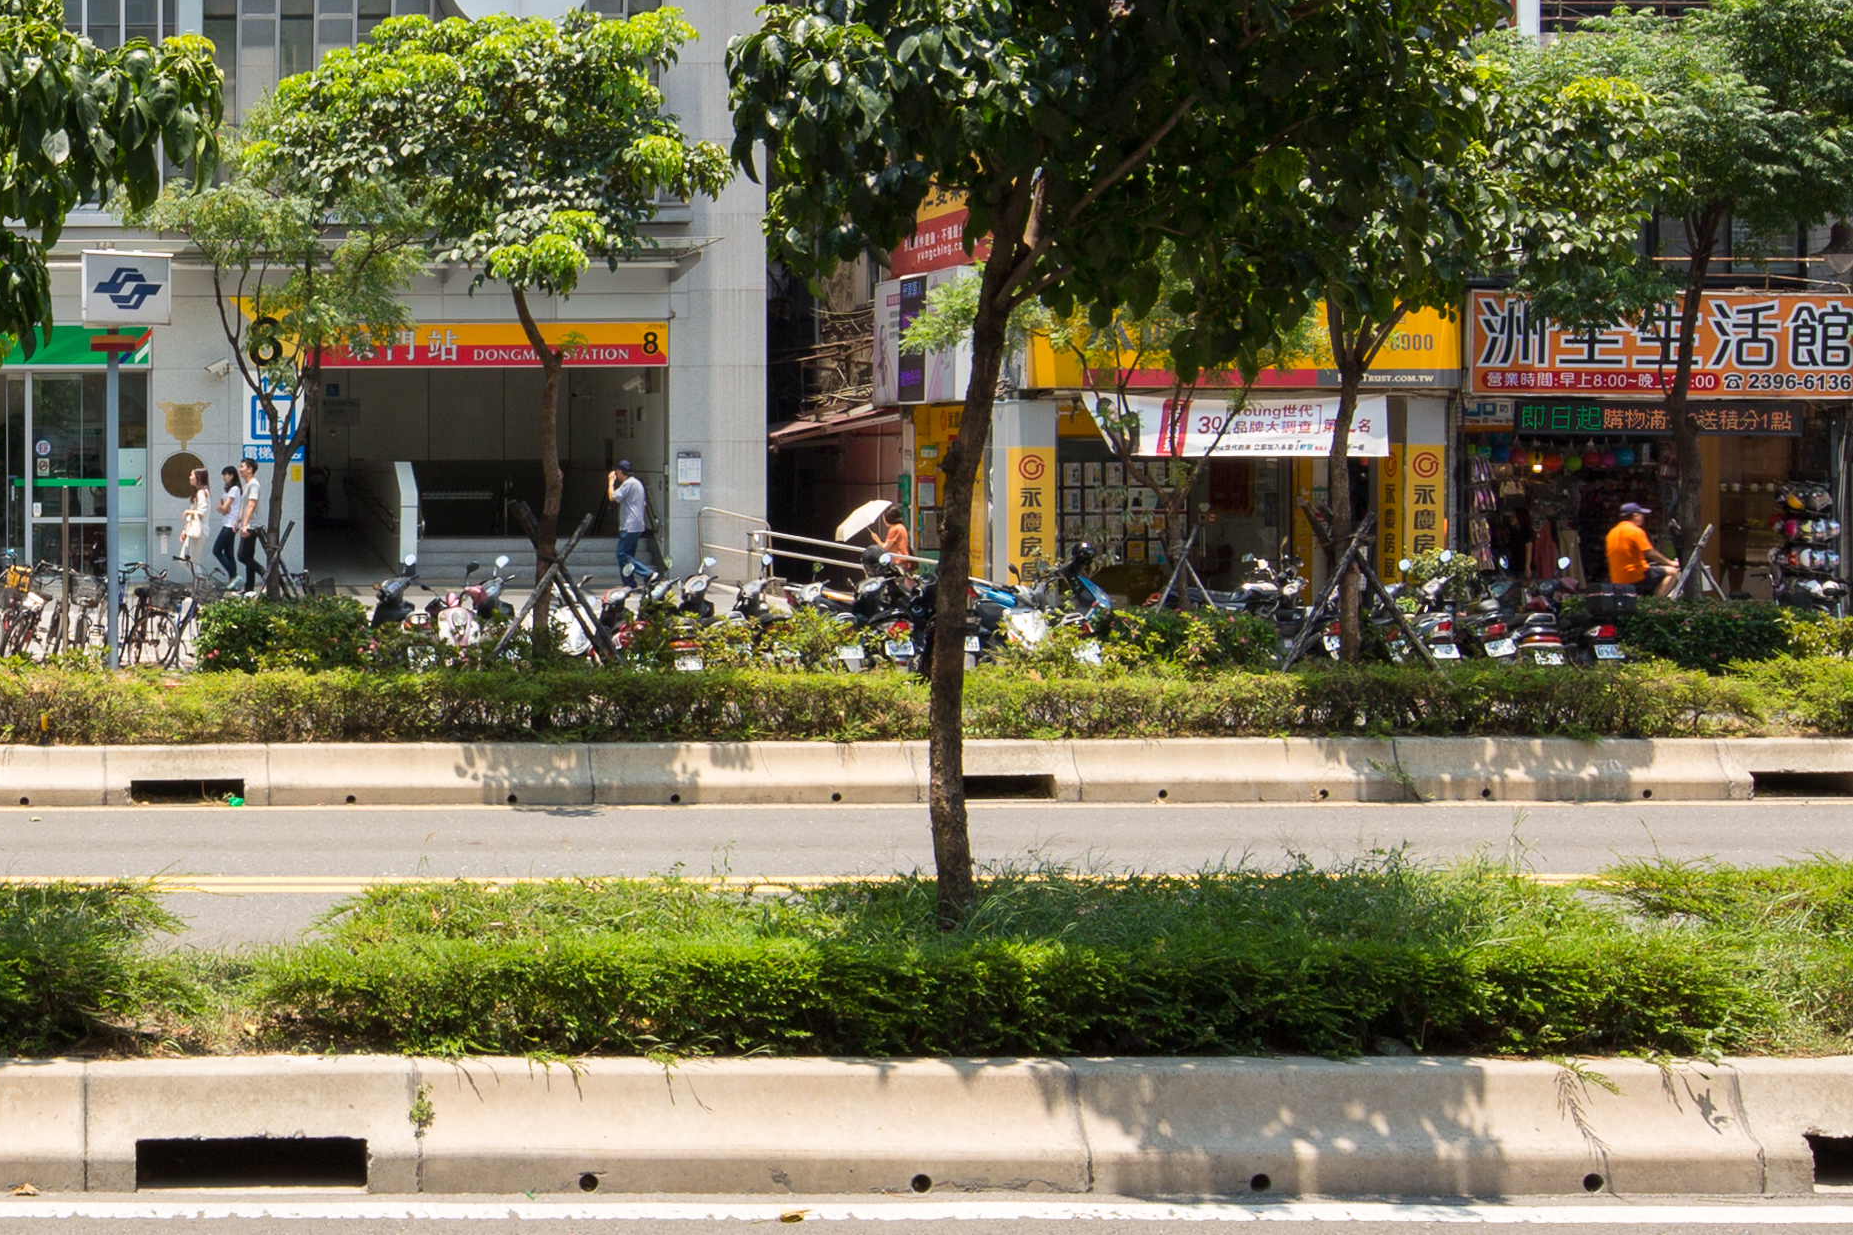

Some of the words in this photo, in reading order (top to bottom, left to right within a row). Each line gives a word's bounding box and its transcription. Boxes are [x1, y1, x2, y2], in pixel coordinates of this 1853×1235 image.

[642, 331, 659, 356] 8
[473, 348, 555, 361] DONGM
[562, 347, 630, 361] STATION
[1747, 372, 1853, 392] 2396-6136
[1232, 419, 1313, 434] 品牌大調查
